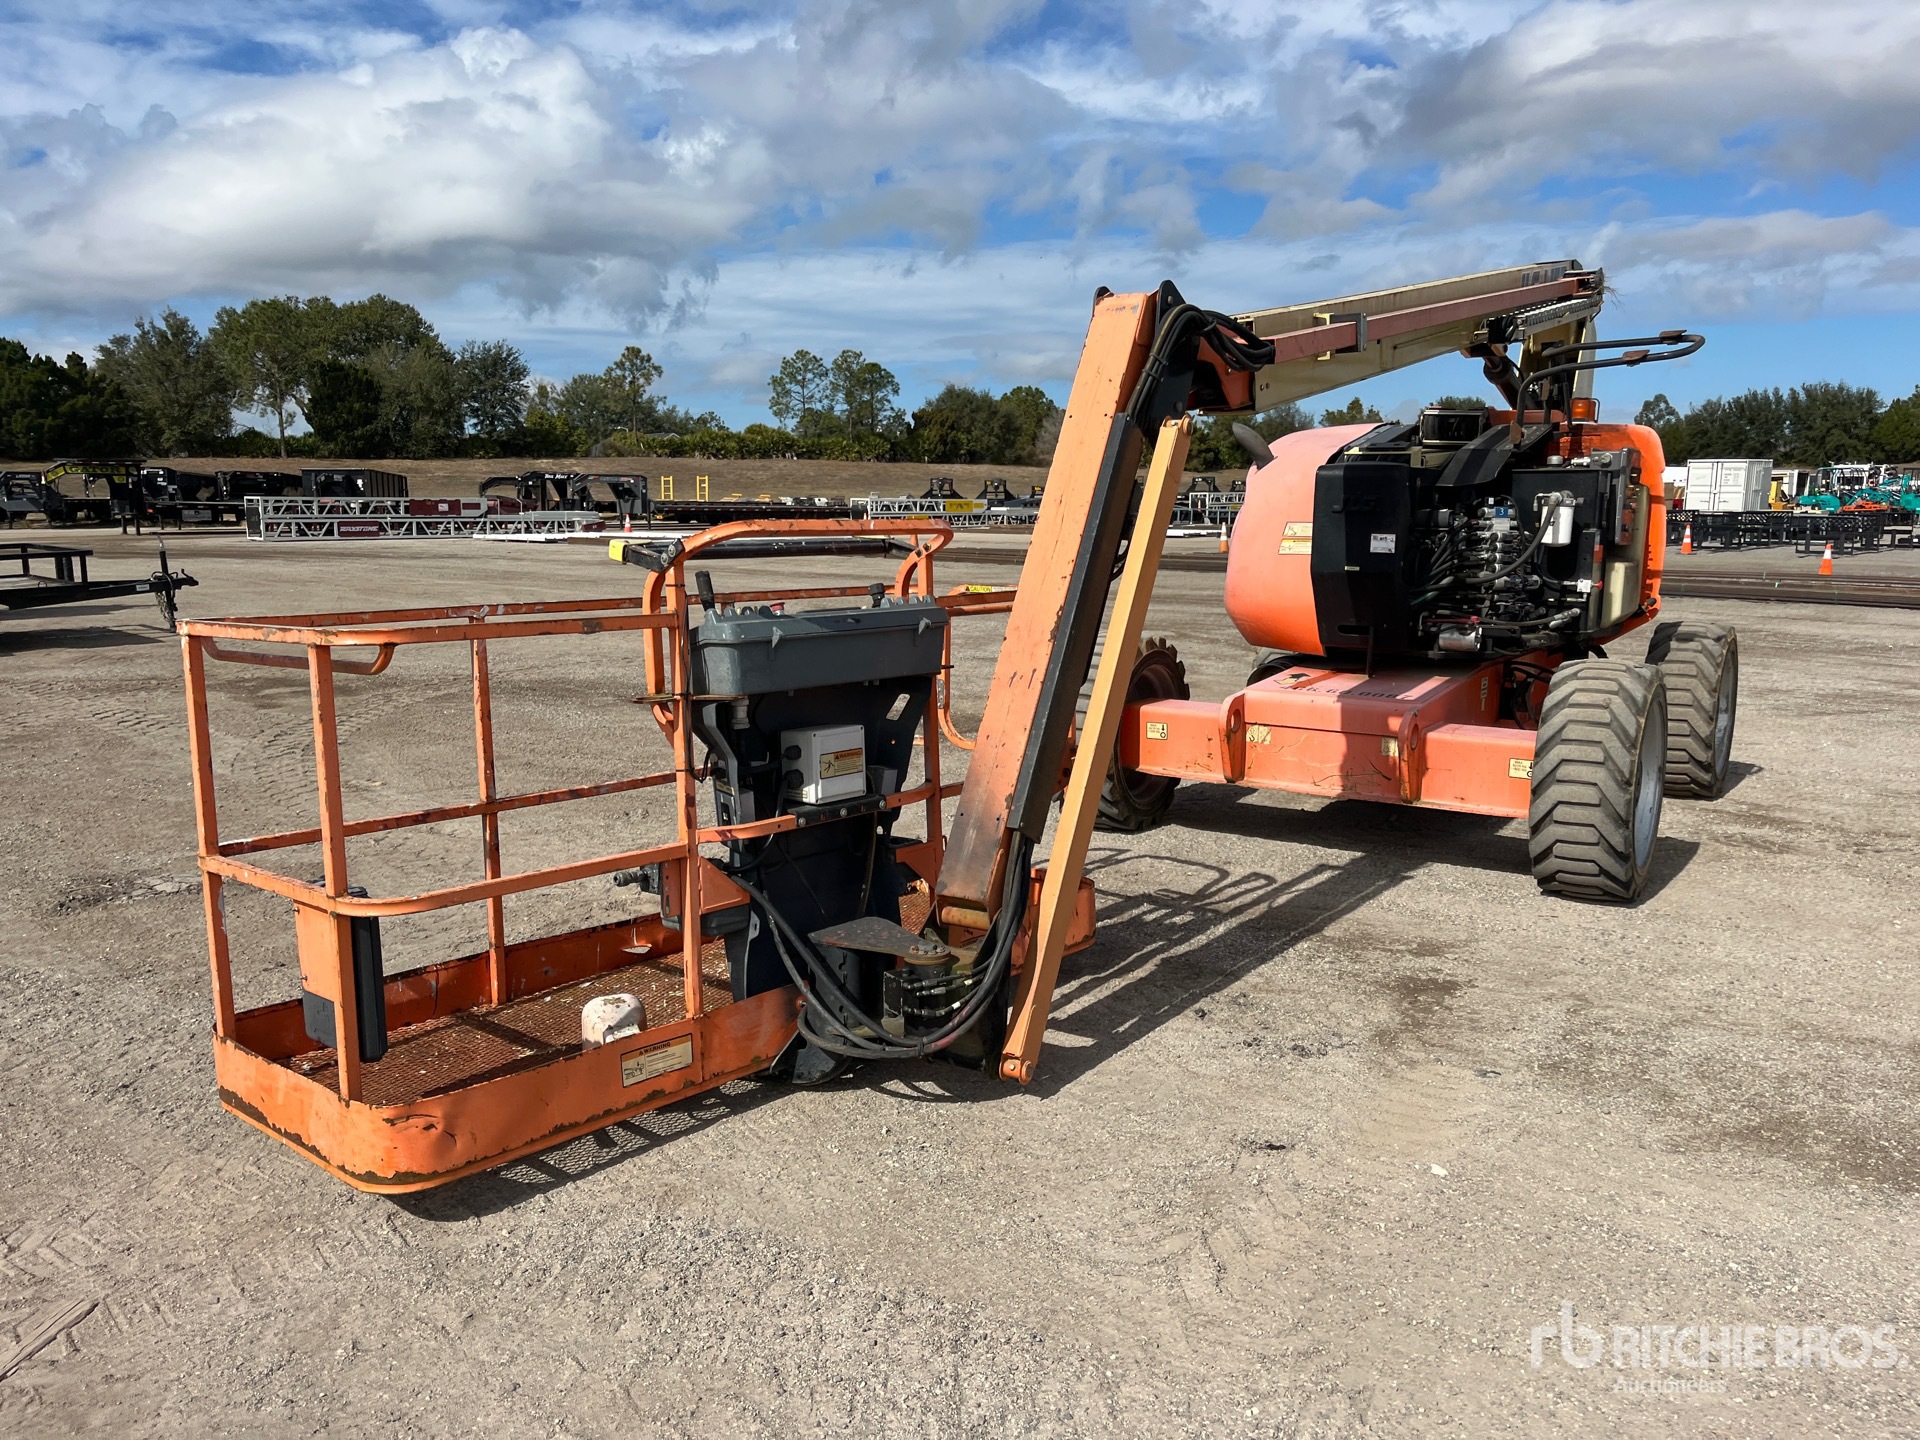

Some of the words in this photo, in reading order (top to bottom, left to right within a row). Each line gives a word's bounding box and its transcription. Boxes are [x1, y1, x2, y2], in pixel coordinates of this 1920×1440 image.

[69, 465, 122, 474] GATOR
[1499, 507, 1505, 516] 3
[839, 749, 862, 759] WARNING
[644, 1042, 671, 1053] WARNING
